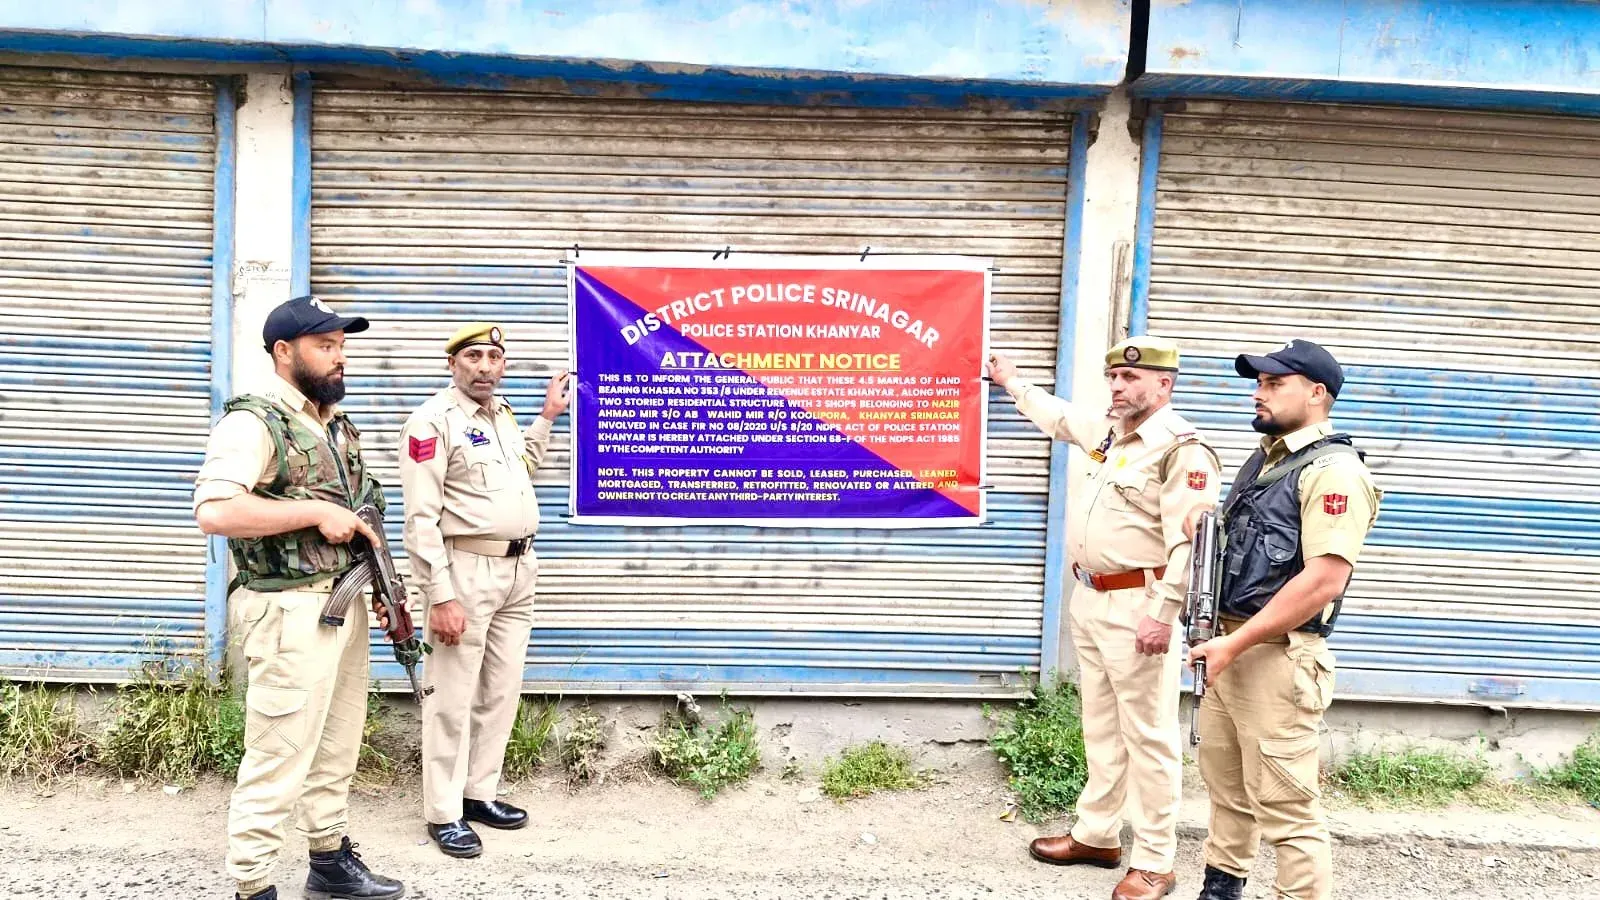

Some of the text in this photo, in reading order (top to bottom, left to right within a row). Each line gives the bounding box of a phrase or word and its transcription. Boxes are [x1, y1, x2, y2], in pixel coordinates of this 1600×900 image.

[620, 284, 940, 348] DISTRICT POLICE SRINAGAR
[681, 324, 880, 338] POLICE STATION KHANYAR
[660, 352, 900, 369] ATTACHMENT NOTICE
[599, 374, 620, 382] THIS
[623, 374, 632, 382] IS
[652, 375, 690, 383] INFORM
[693, 375, 712, 383] THE
[715, 375, 757, 383] GENERAL
[826, 376, 855, 384] THESE
[858, 376, 873, 384] 4.5
[733, 387, 764, 395] UNDER
[936, 388, 960, 396] WITH
[624, 398, 664, 406] STORIED
[787, 399, 812, 407] WITH
[932, 400, 960, 408] NAZIR
[598, 410, 636, 418] AHMAD
[639, 410, 658, 418] MIR
[662, 409, 680, 419] S/O
[768, 409, 787, 420] R/O
[598, 422, 646, 430] INVOLVED
[650, 422, 659, 430] IN
[663, 422, 688, 430] CASE
[727, 421, 767, 431] 08/2020
[770, 421, 787, 432] U/S
[791, 421, 813, 432] 8/20
[845, 423, 864, 431] ACT
[868, 423, 880, 431] OF
[697, 434, 749, 442] ATTACHED
[598, 445, 611, 453] BY
[612, 445, 630, 453] THE
[689, 446, 744, 454] AUTHORITY
[632, 469, 654, 477] THIS
[658, 469, 710, 477] PROPERTY
[713, 469, 757, 477] CANNOT
[761, 469, 773, 477] BE
[777, 469, 806, 478] SOLD,
[810, 470, 849, 478] LEASED,
[853, 470, 916, 478] PURCHASED,
[598, 481, 664, 490] MORTGAGED,
[668, 481, 739, 490] TRANSFERRED,
[743, 481, 809, 490] RETROFITTED,
[598, 492, 634, 500] OWNER
[635, 492, 657, 500] NOT
[795, 493, 841, 501] INTEREST.
